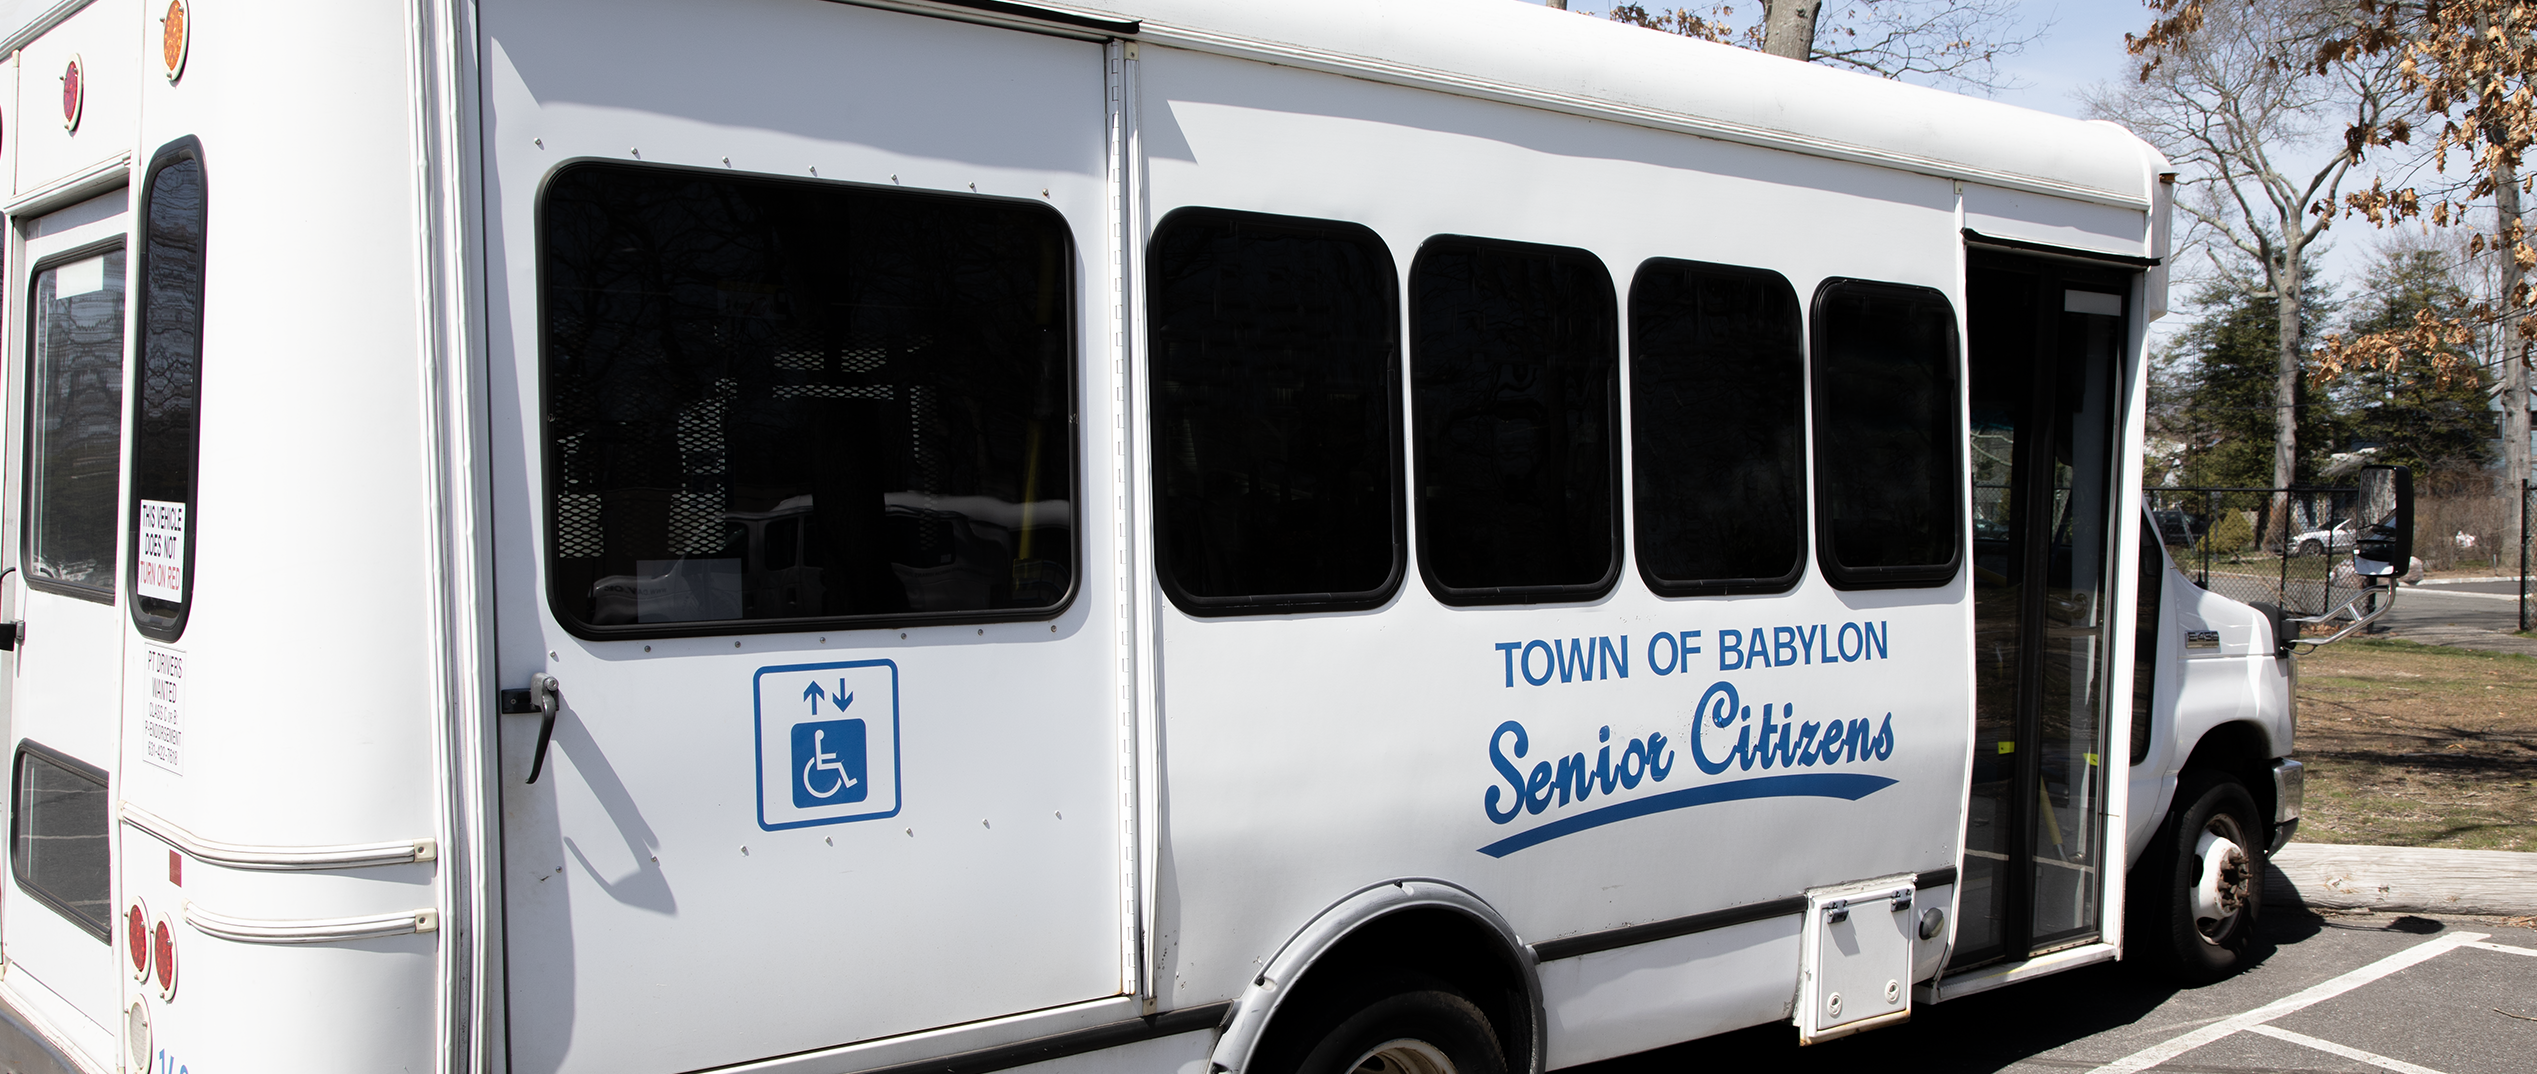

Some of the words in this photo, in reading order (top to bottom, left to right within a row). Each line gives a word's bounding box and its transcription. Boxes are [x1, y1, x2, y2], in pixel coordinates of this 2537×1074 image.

[143, 504, 156, 528] THIS
[157, 506, 182, 531] VEHICLE
[145, 533, 161, 557] DOES
[164, 535, 177, 559] NOT
[140, 561, 156, 585] TURN
[157, 564, 166, 588] ON
[168, 566, 180, 590] RED
[148, 650, 156, 671] PT
[157, 653, 183, 678] DRIVERS
[1495, 635, 1629, 688] TOWN
[1648, 630, 1701, 676] OF
[1719, 621, 1888, 671] BABYLON
[152, 677, 177, 703] WANTED
[149, 702, 163, 720] CLASS
[1484, 720, 1675, 825] Senior
[1690, 681, 1895, 776] Citizens
